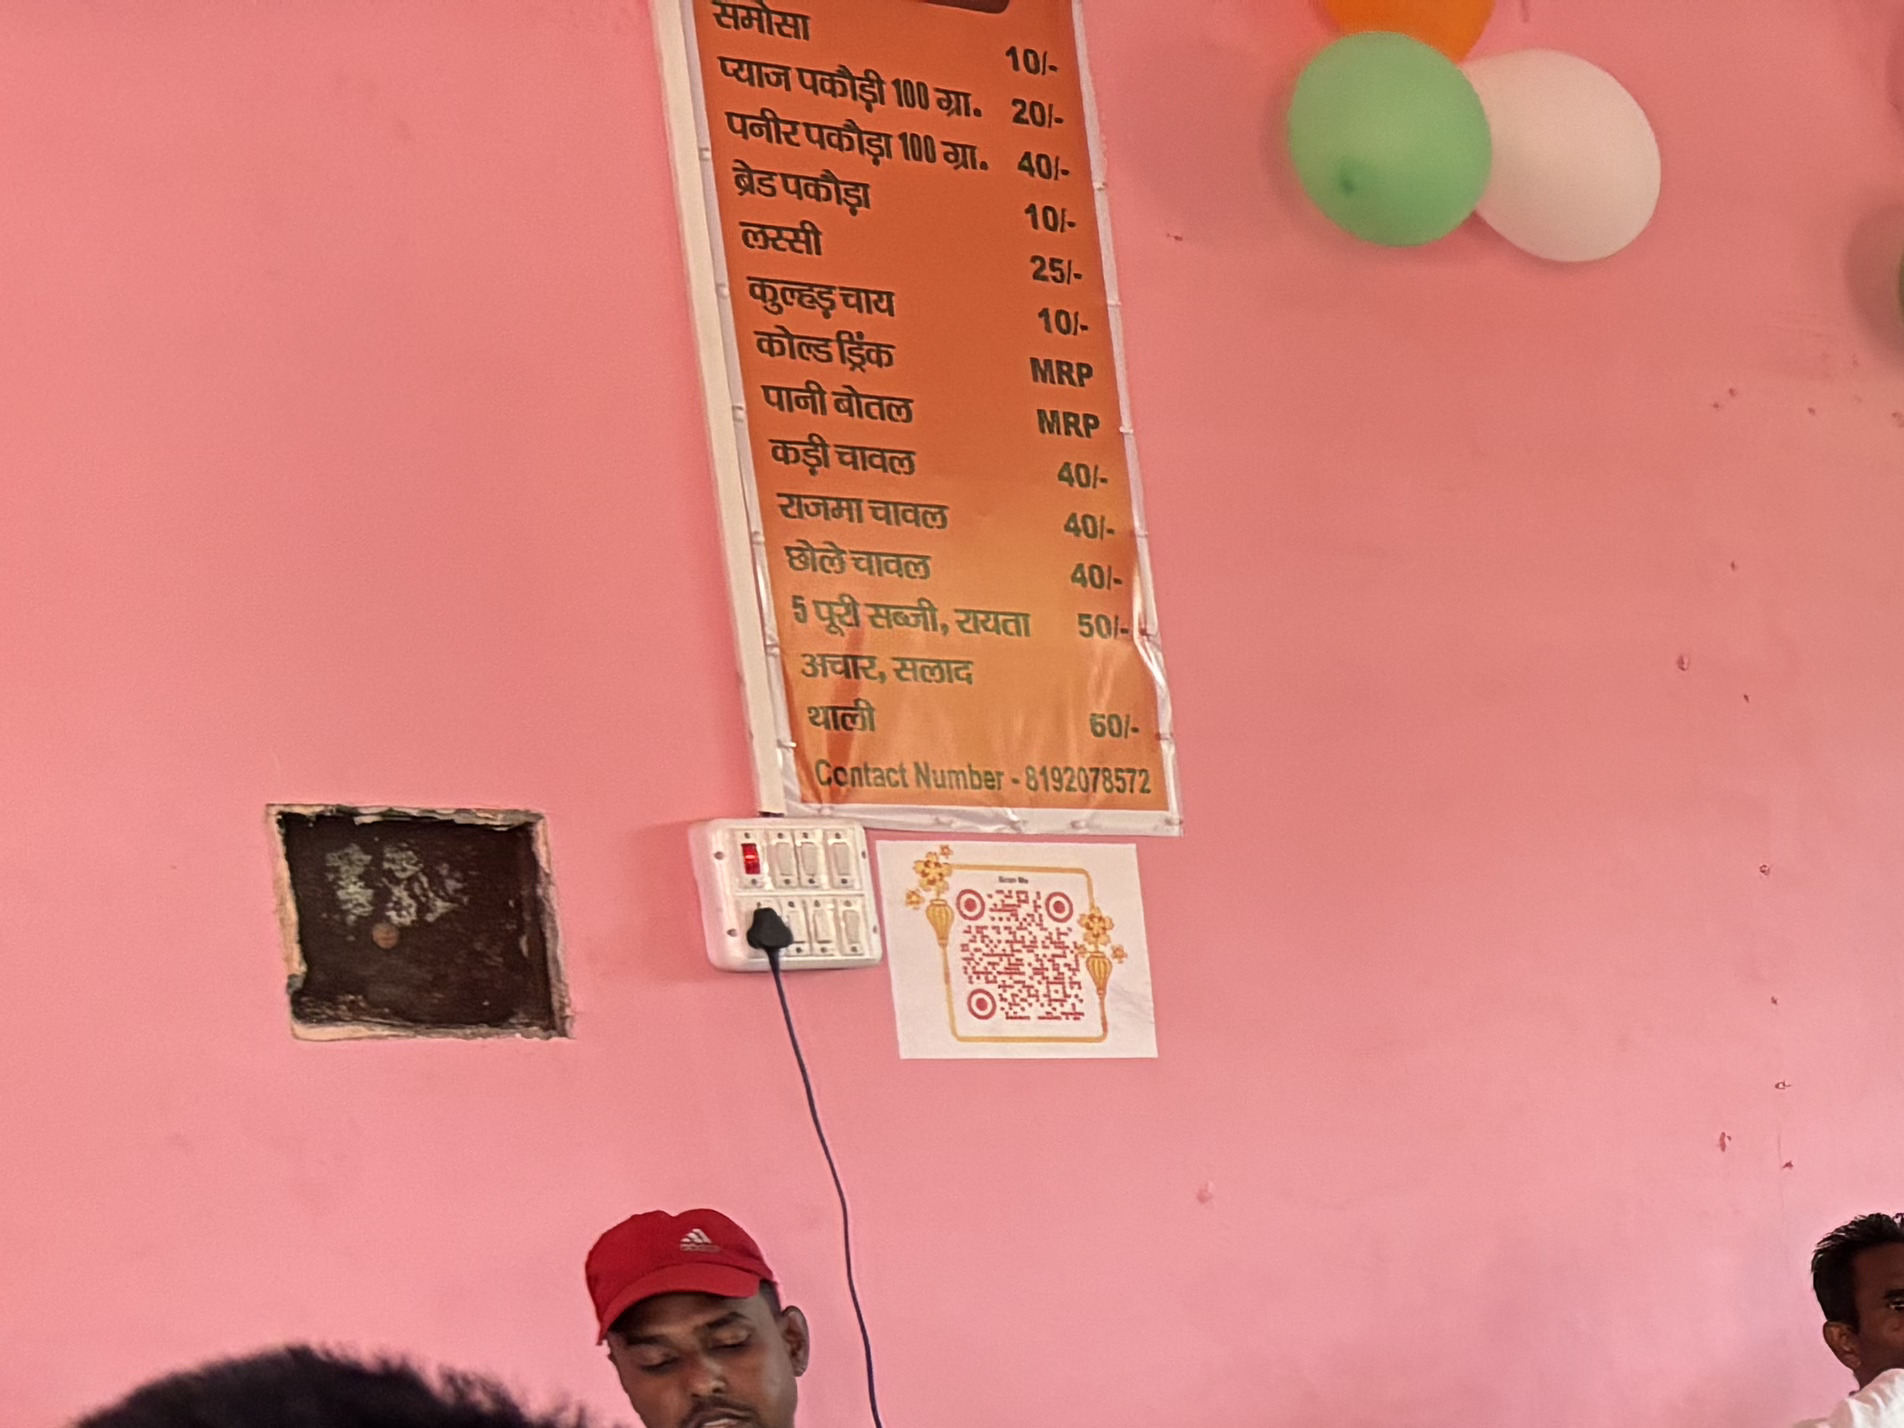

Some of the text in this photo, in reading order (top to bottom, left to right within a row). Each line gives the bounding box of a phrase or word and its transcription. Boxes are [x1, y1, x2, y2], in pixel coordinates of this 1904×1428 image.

[1005, 45, 1059, 76] 10/-
[717, 55, 1065, 129] प्याज पकौड़ी 100 ग्रा. 20/-
[724, 107, 1070, 181] पनीर पकौड़ा 100 ग्रा. 40/-
[731, 158, 1077, 233] ब्रेड पकौड़ा 10/-
[738, 219, 1083, 285] लस्सी 25/-
[838, 286, 896, 318] चाय
[1037, 307, 1089, 337] 10/-
[753, 324, 837, 364] कोल्ड
[1029, 356, 1094, 388] MRP
[760, 379, 1101, 439] पानी बोतल MRP
[834, 444, 917, 476] चावल
[1057, 461, 1109, 489] 40/-
[775, 492, 1116, 541] राजमा चावल 40/-
[783, 538, 1123, 591] छोले चावल 40/-
[791, 594, 808, 624] 5
[811, 593, 861, 637] पूरी
[953, 608, 1031, 638] रायता
[1077, 613, 1131, 639] 50/-
[800, 653, 974, 686] अचार, सलाद
[807, 697, 1141, 740] थाली 60/-
[815, 759, 909, 788] Contact
[913, 761, 1005, 792] Number
[1025, 765, 1152, 795] 8192078572
